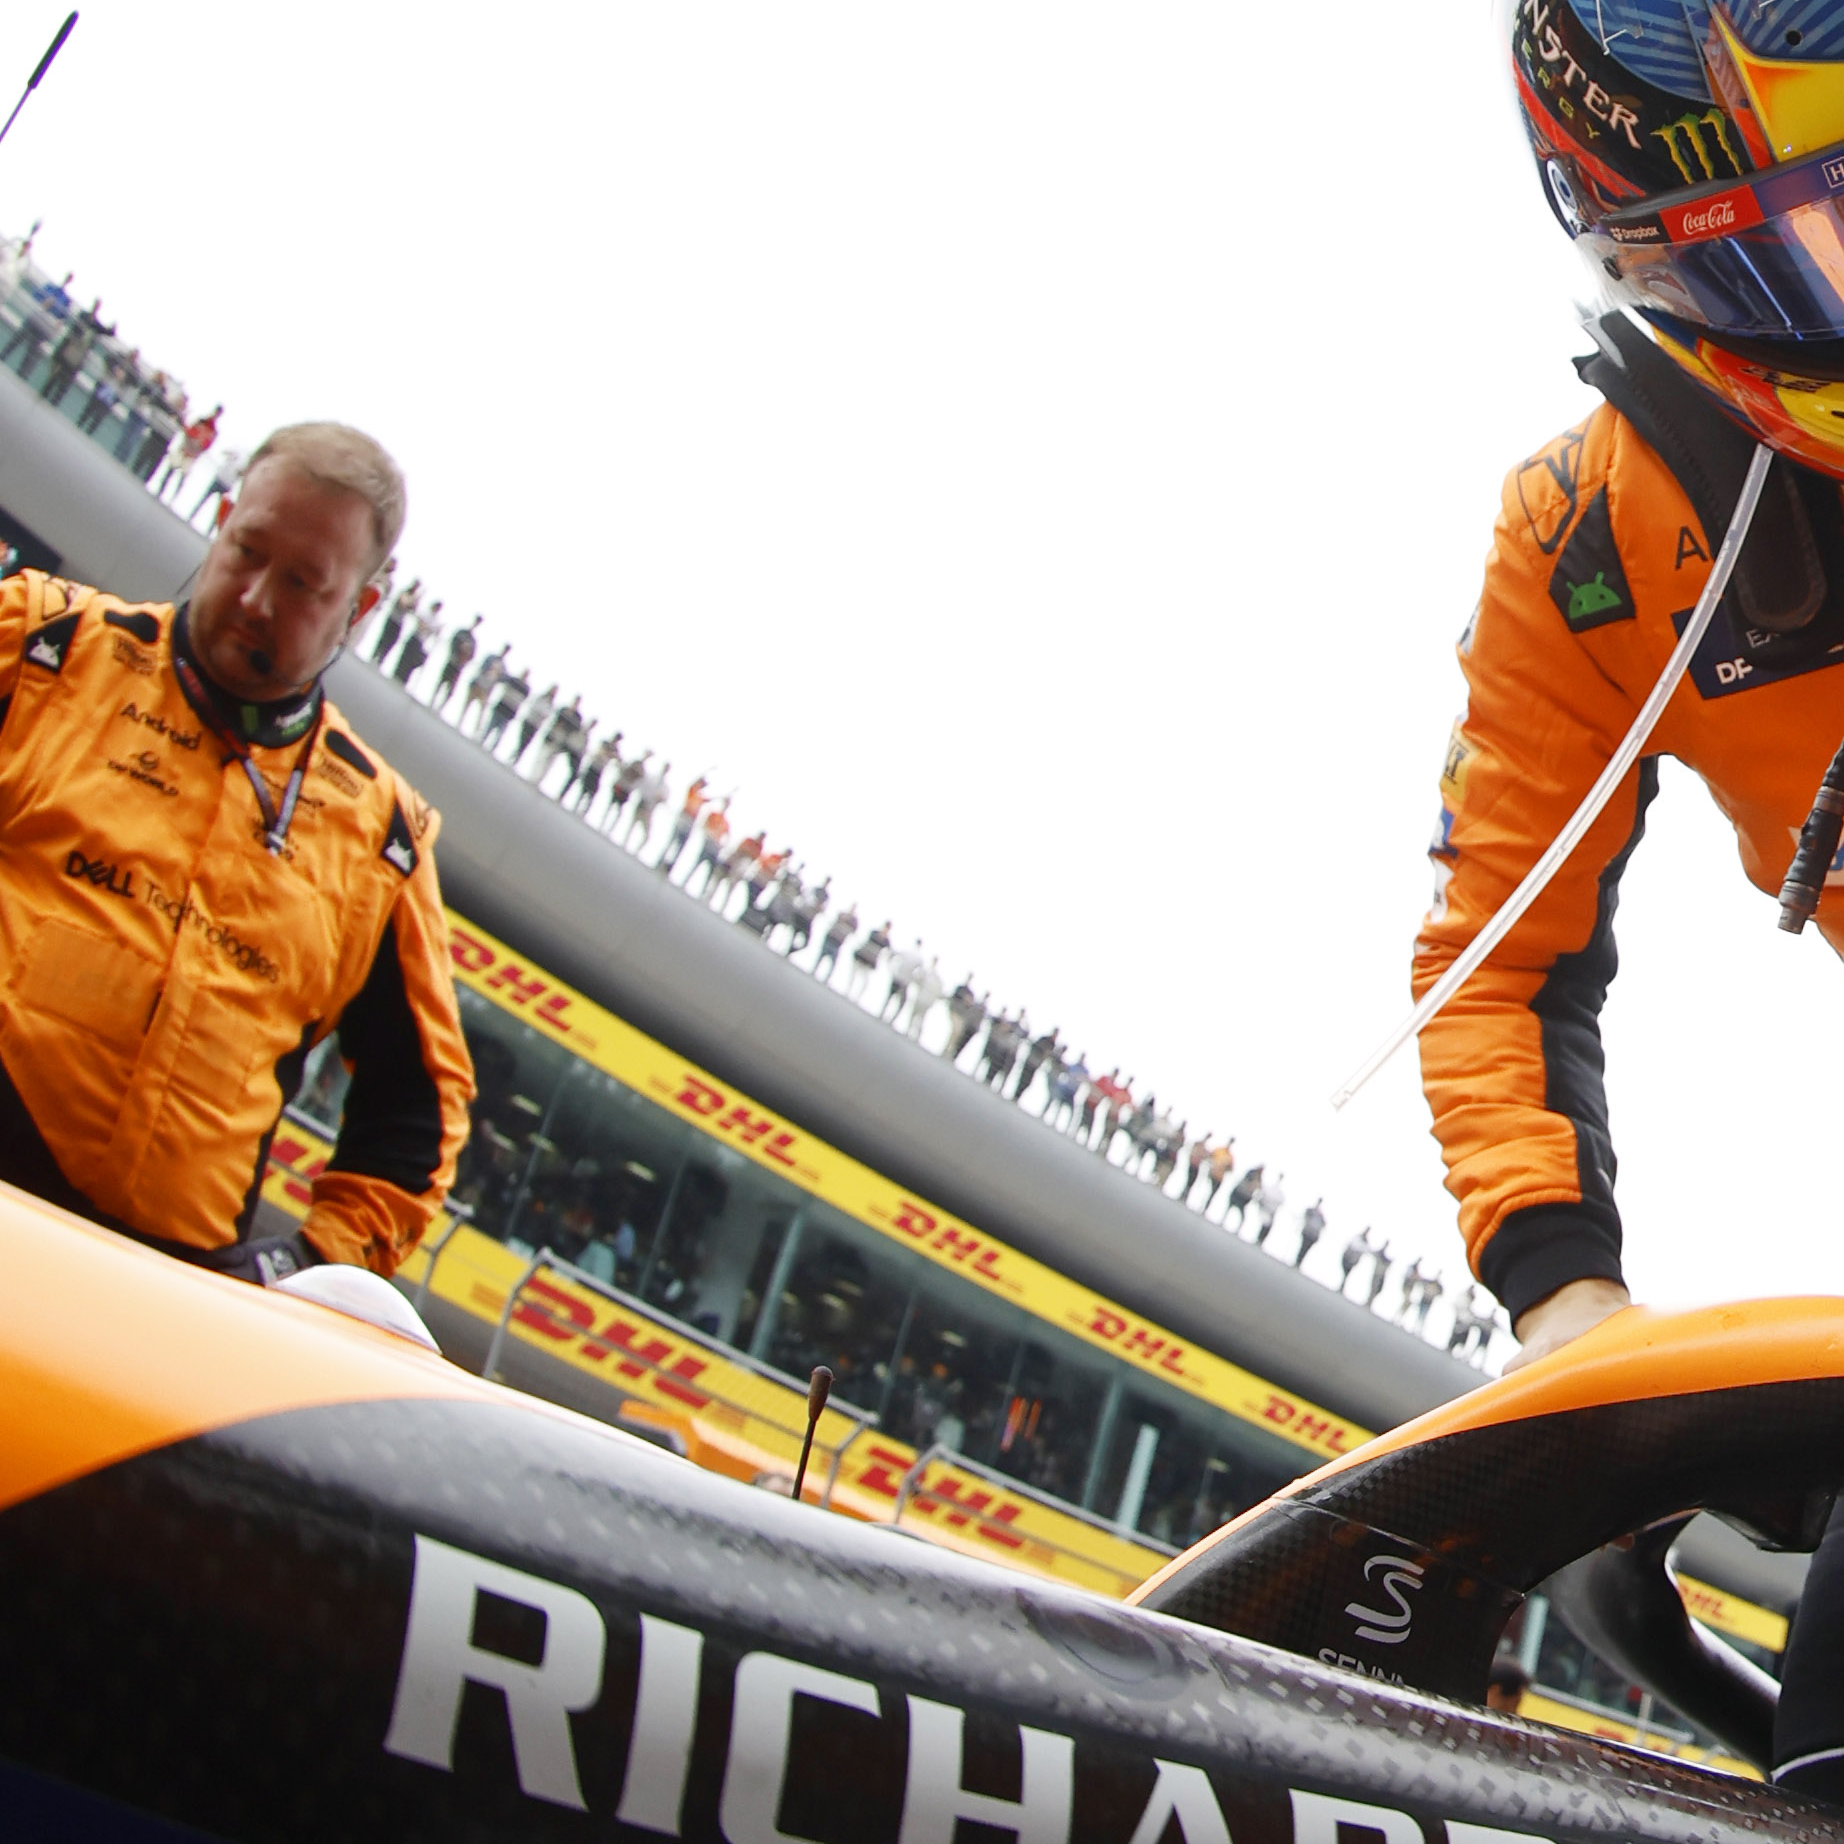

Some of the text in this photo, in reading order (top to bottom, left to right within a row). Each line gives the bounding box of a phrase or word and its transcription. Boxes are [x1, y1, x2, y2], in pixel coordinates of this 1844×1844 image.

[1621, 226, 1659, 241] Dropbox
[1682, 200, 1736, 235] Coca-Cola
[65, 850, 280, 984] DELL Technologies
[450, 926, 572, 1033] DHL
[674, 1074, 797, 1168] DHL
[892, 1201, 1002, 1282] DHL
[511, 1273, 712, 1410] DHL
[1086, 1306, 1189, 1377] DHL
[1261, 1394, 1348, 1454] DHL
[858, 1445, 1026, 1549] DHL
